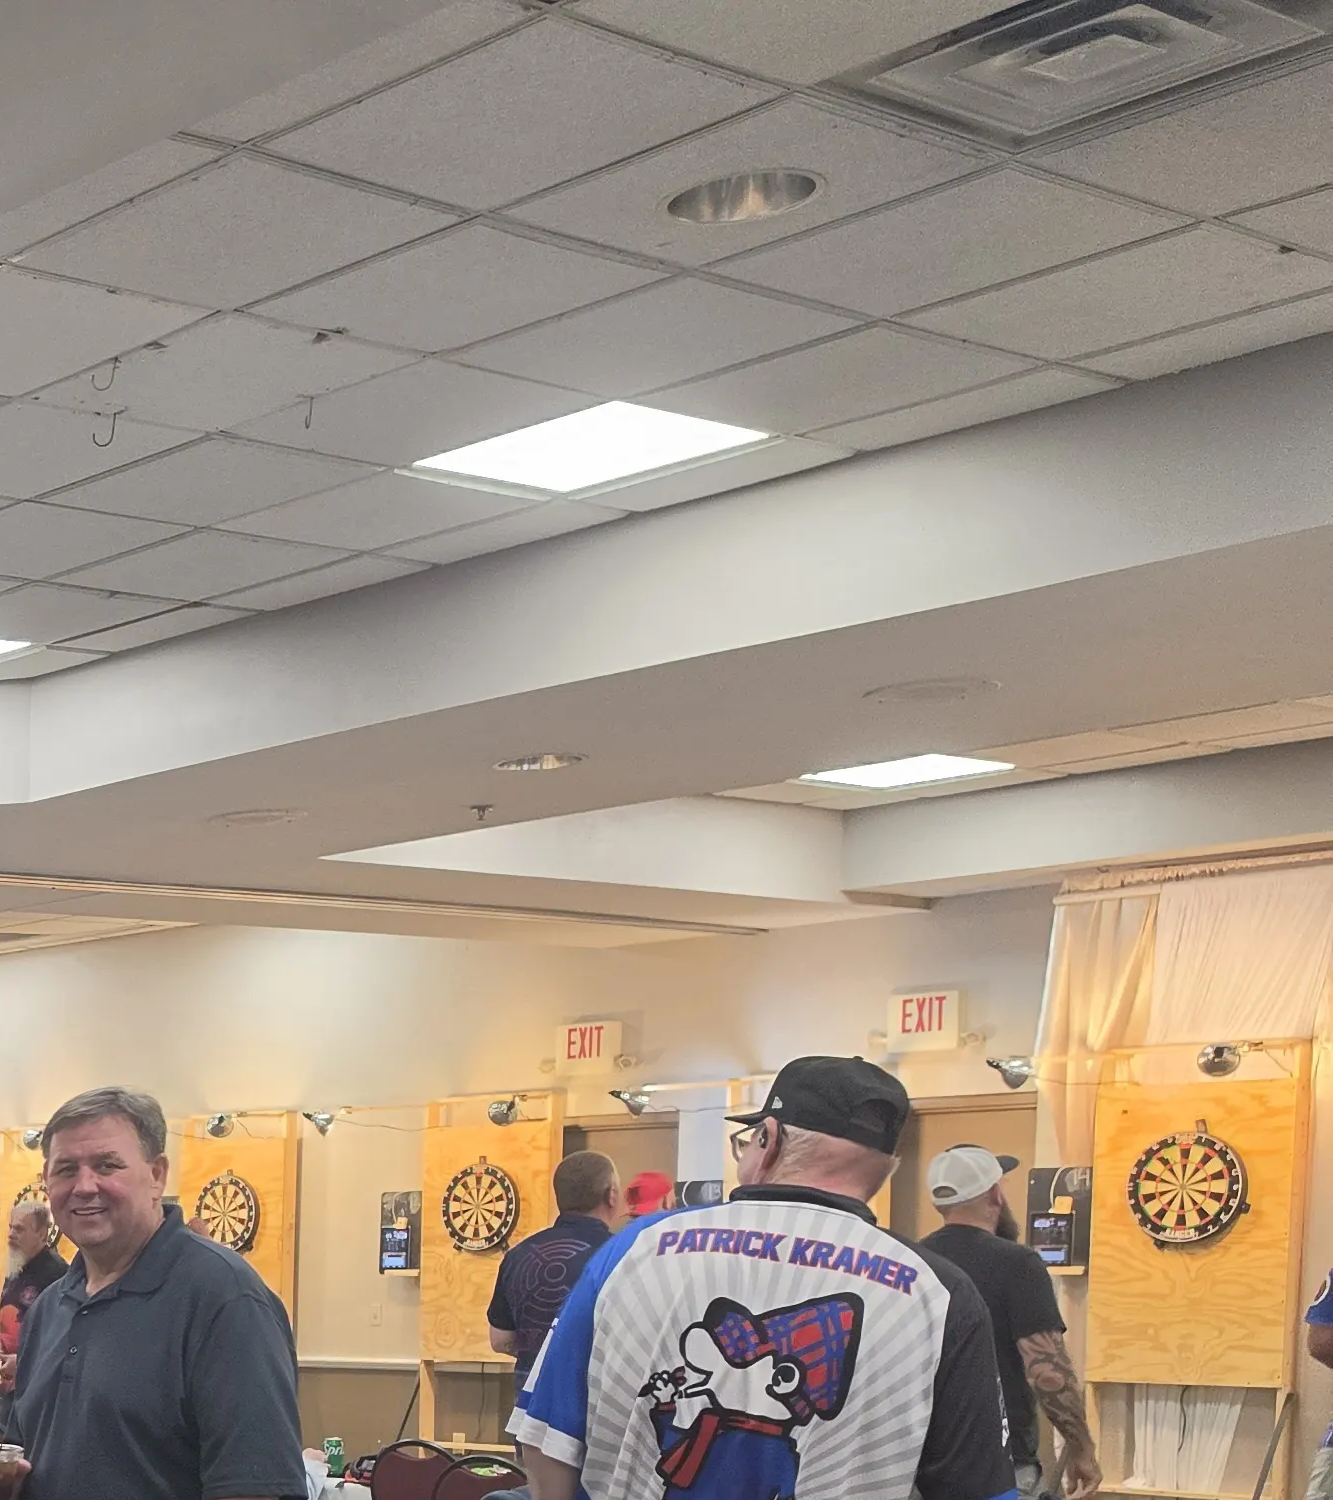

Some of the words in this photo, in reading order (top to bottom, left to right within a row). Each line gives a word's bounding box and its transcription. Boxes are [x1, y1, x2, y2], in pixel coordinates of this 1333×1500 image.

[901, 996, 947, 1034] EXIT
[567, 1025, 604, 1060] EXIT
[656, 1228, 789, 1262] PATRICK
[788, 1236, 919, 1296] KRAMER
